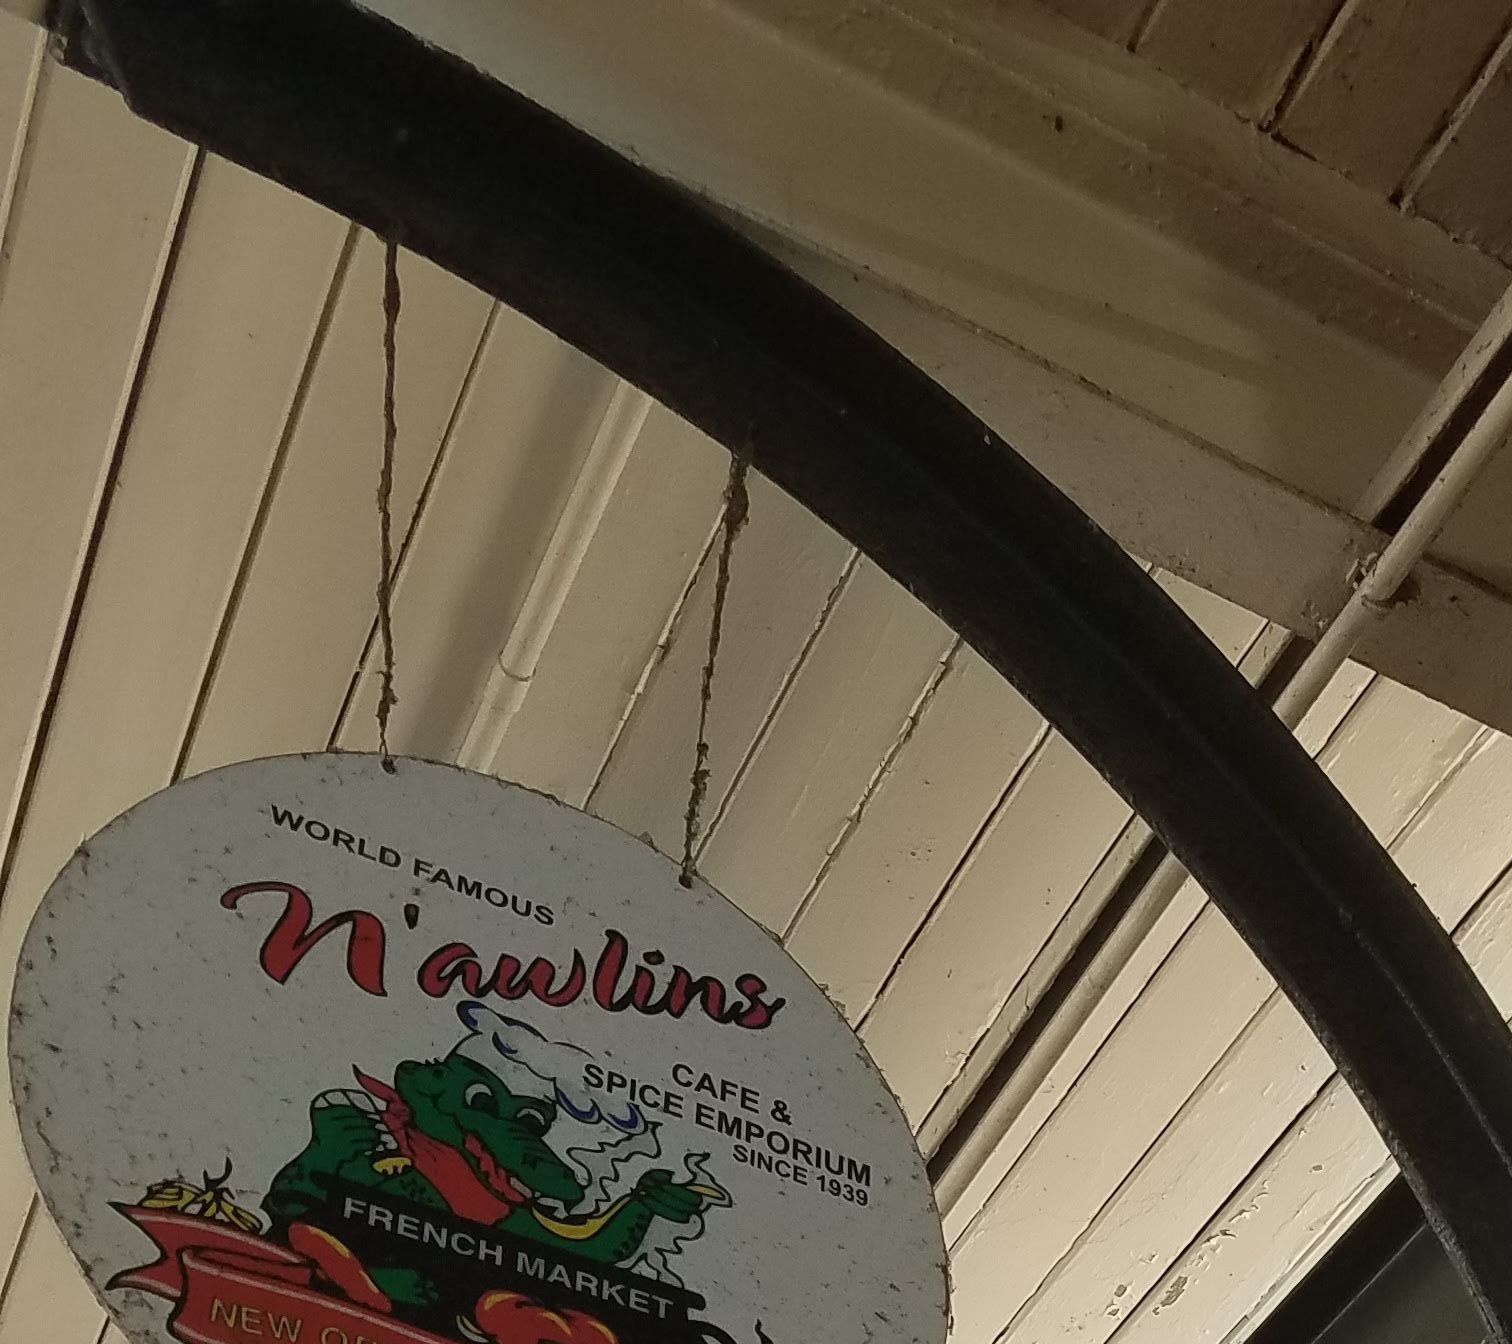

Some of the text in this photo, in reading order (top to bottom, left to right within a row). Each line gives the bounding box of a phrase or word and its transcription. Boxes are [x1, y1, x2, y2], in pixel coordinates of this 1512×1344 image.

[270, 804, 555, 926] WORLD FAMOUS
[582, 1062, 874, 1186] SPICE EMPORIUM
[671, 1062, 794, 1126] CAFE &
[732, 1142, 870, 1207] SINCE 1939
[342, 1196, 675, 1320] FRENCH MARKET
[210, 1294, 304, 1343] NEW
